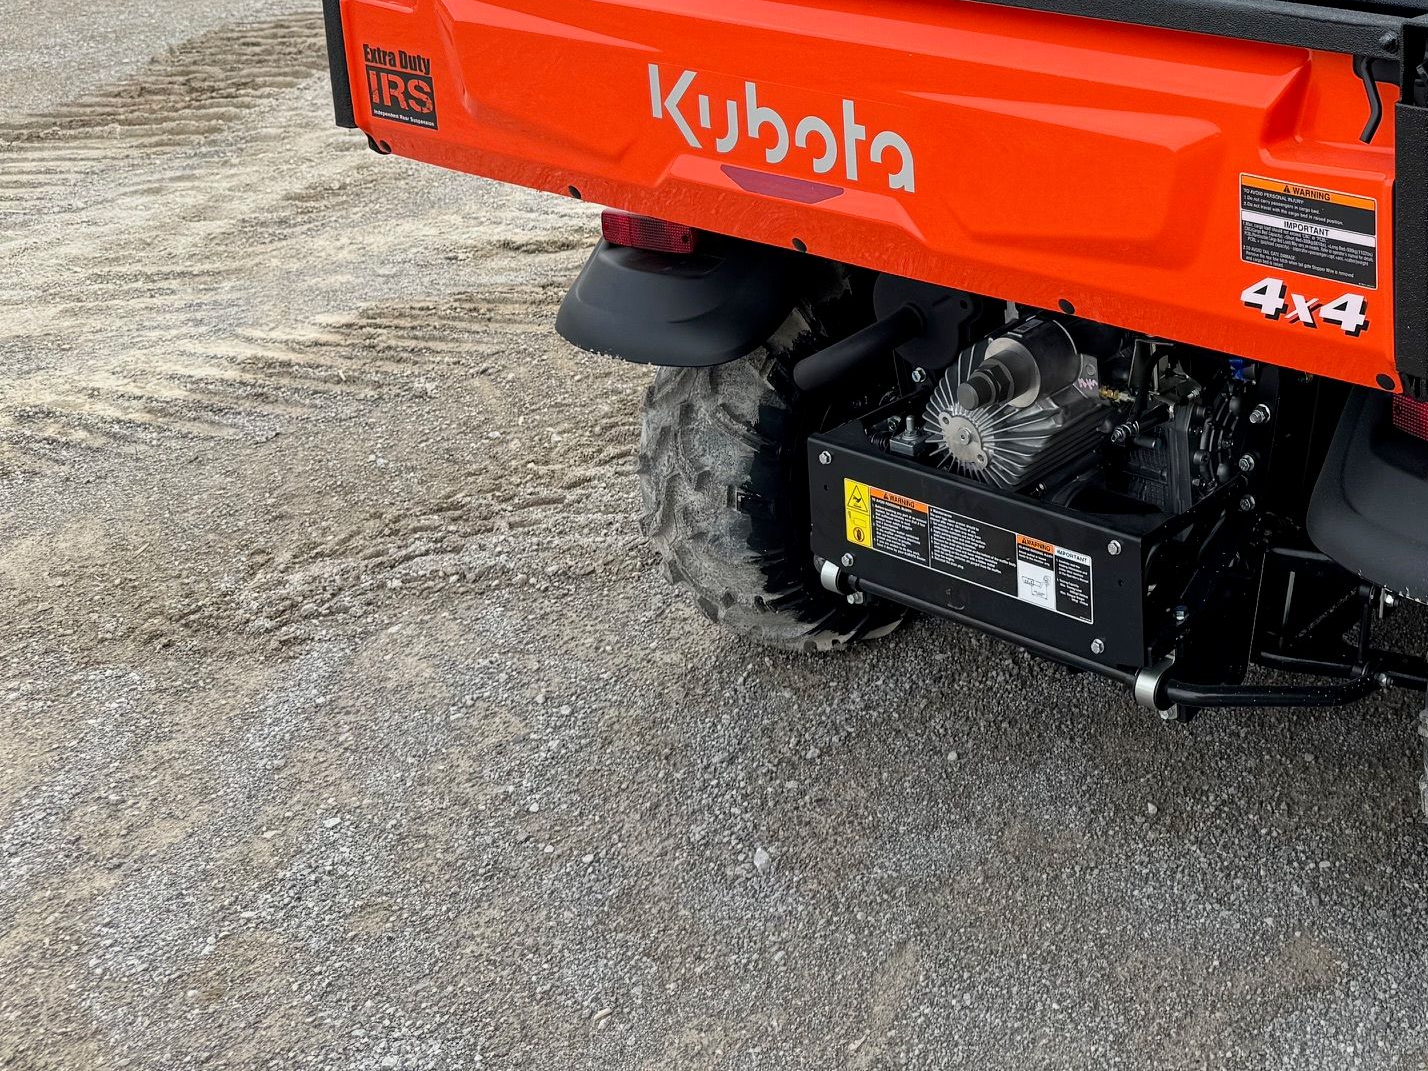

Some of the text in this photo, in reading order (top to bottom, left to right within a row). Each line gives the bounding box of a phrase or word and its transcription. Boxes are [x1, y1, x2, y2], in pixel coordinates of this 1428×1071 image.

[363, 44, 430, 75] Extra Duty
[369, 70, 433, 114] IRS
[648, 63, 915, 193] Kubota
[1292, 186, 1331, 202] WARNING
[1283, 221, 1331, 236] IMPORTANT
[889, 494, 915, 508] WARNING
[1026, 540, 1051, 551] WARNING
[1057, 549, 1087, 563] IMPORTANT
